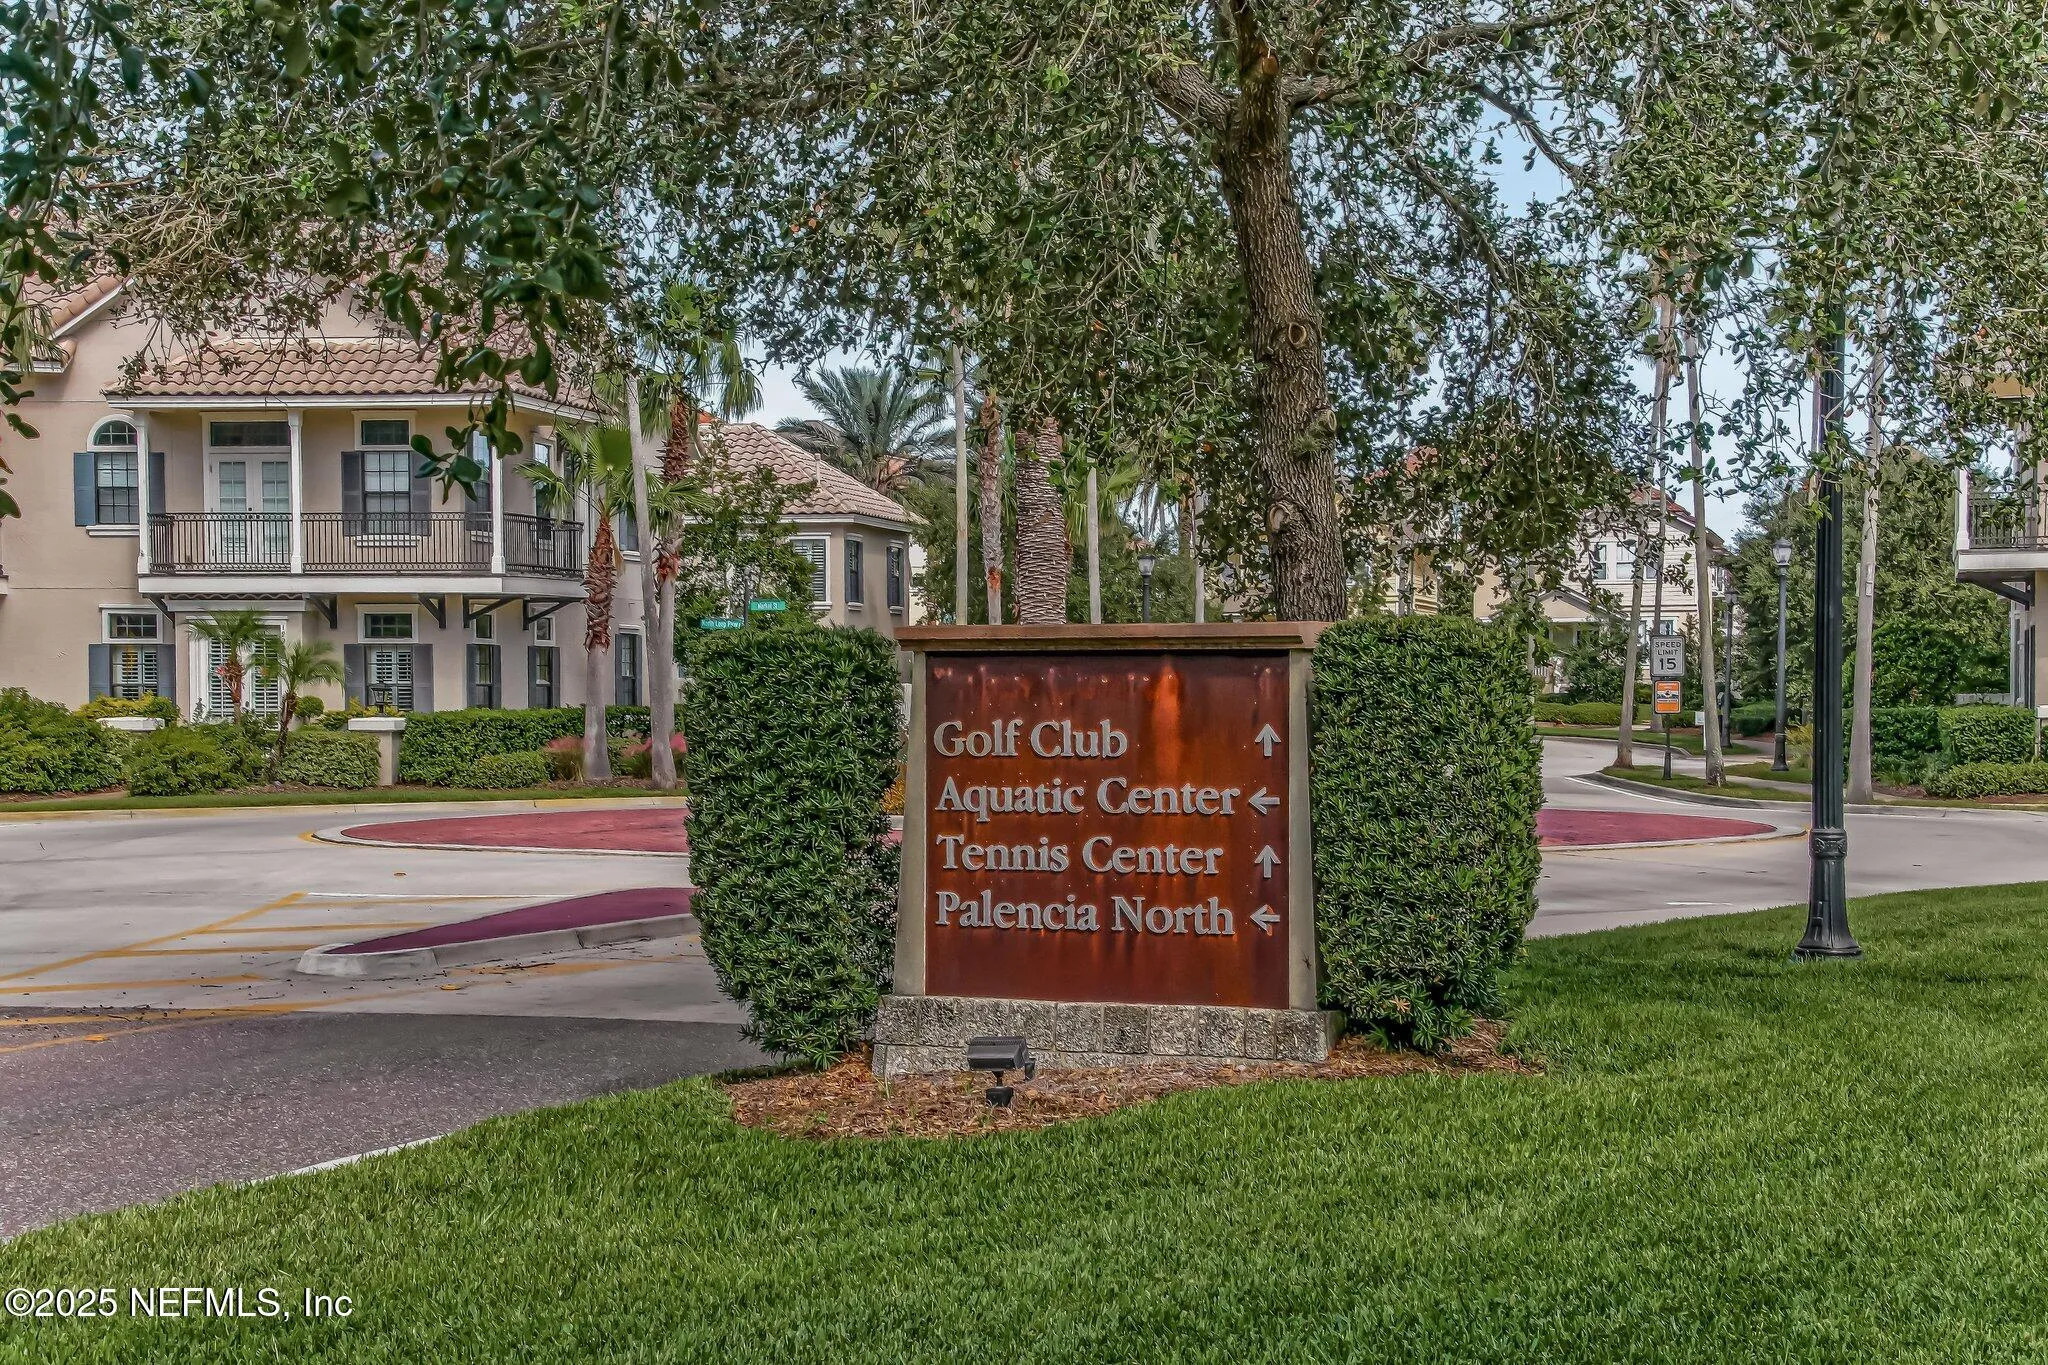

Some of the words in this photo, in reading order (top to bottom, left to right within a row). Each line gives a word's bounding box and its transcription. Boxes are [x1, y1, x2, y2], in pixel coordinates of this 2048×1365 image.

[1659, 657, 1677, 670] 15
[933, 719, 1023, 757] Golf
[1030, 719, 1128, 758] Club
[934, 776, 1085, 822] Aquatic
[1097, 776, 1240, 816] Center
[936, 834, 1069, 872] Tennis
[1082, 835, 1223, 875] Center
[935, 889, 1100, 932] Palencia
[1111, 896, 1236, 935] North
